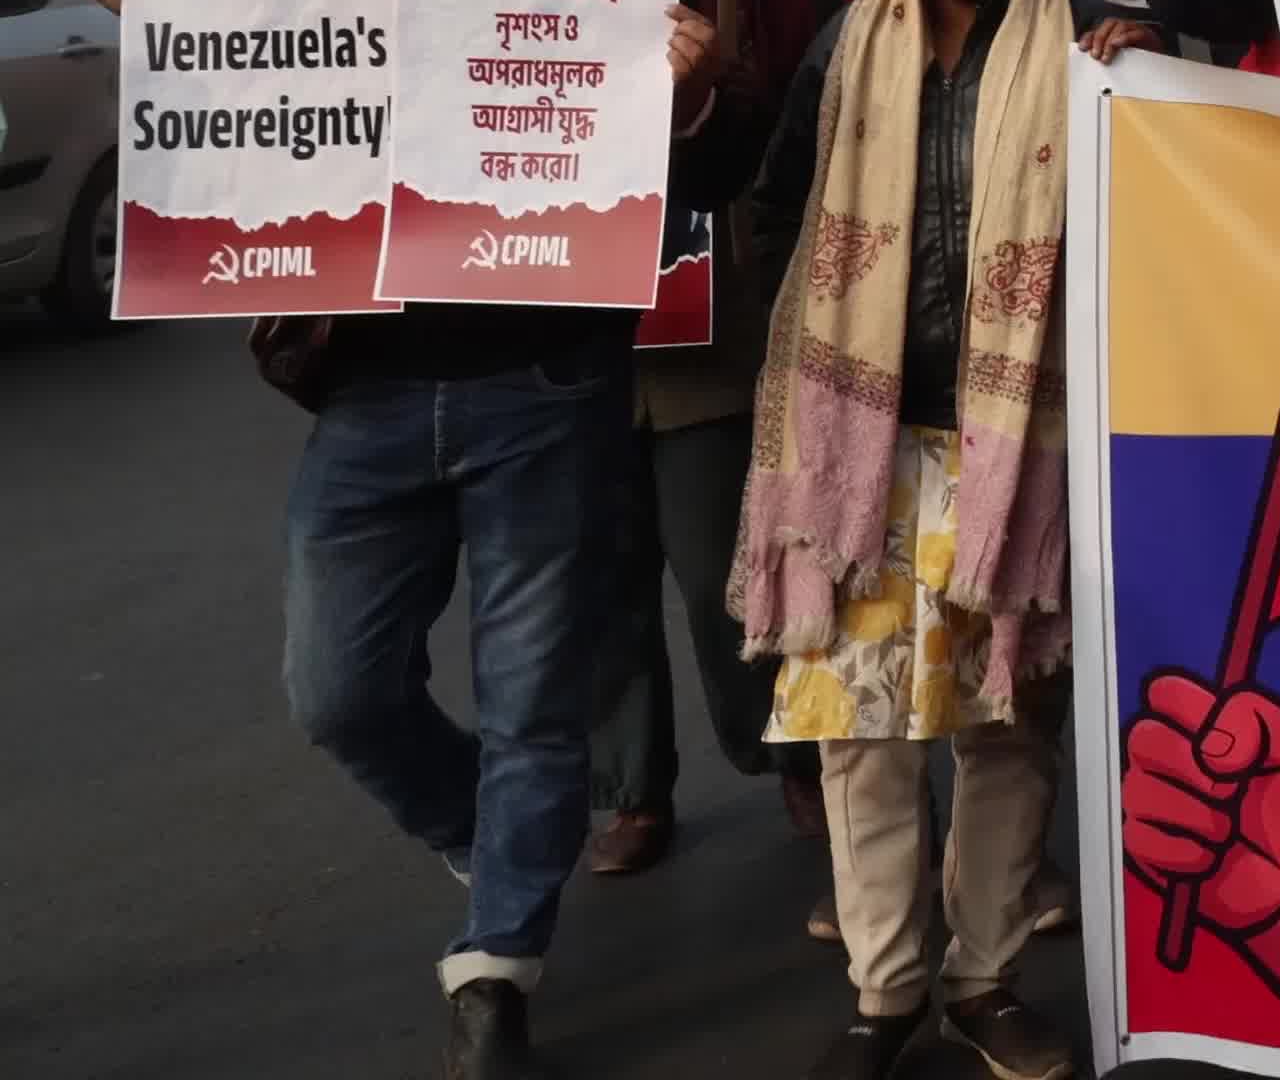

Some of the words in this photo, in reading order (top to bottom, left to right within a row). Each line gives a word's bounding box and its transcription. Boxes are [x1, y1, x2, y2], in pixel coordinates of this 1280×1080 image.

[145, 16, 388, 72] Venezuela's
[496, 12, 560, 51] নৃশংস
[563, 14, 579, 41] ও
[467, 57, 606, 99] অপরাধমূলক
[472, 96, 555, 134] আগ্রাসী
[558, 106, 598, 145] যুদ্ধ
[481, 151, 518, 183] বন্ধ
[243, 246, 316, 278] CPIML
[501, 235, 571, 268] CPIML
